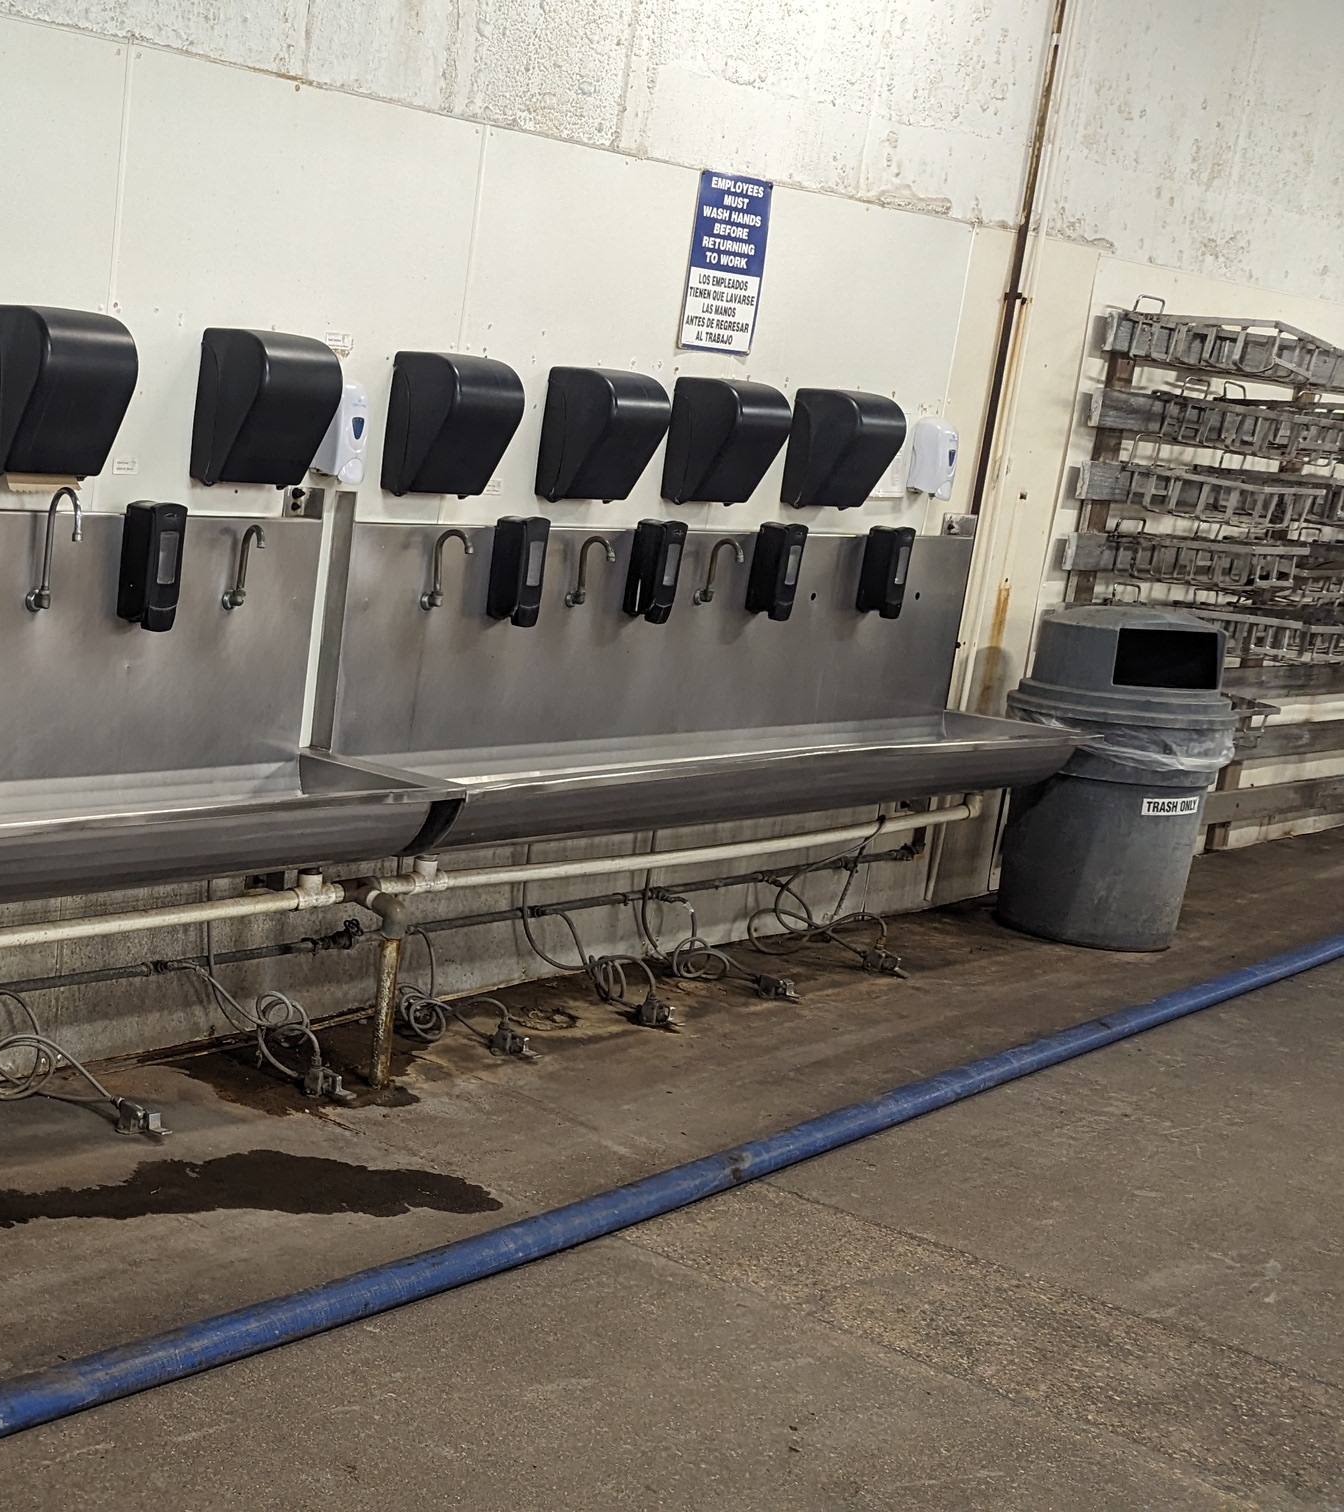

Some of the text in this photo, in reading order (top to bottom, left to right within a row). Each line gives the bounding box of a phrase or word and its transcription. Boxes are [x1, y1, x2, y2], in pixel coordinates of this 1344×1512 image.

[711, 176, 764, 198] EMPLOYEES
[723, 194, 749, 209] MUST
[703, 205, 762, 227] WASH HANDS
[713, 223, 749, 240] BEFORE
[702, 236, 755, 256] RETURNING
[705, 251, 748, 269] TO WORK
[698, 273, 748, 292] LOS EMPLEADOS
[689, 286, 755, 307] TIENEN QUE LAVARSE
[701, 302, 736, 318] LAS MANOS
[685, 315, 749, 334] ANTES DE REGRESAR
[695, 330, 733, 345] AL TRABAJO
[1146, 800, 1197, 813] TRASH ONLY
